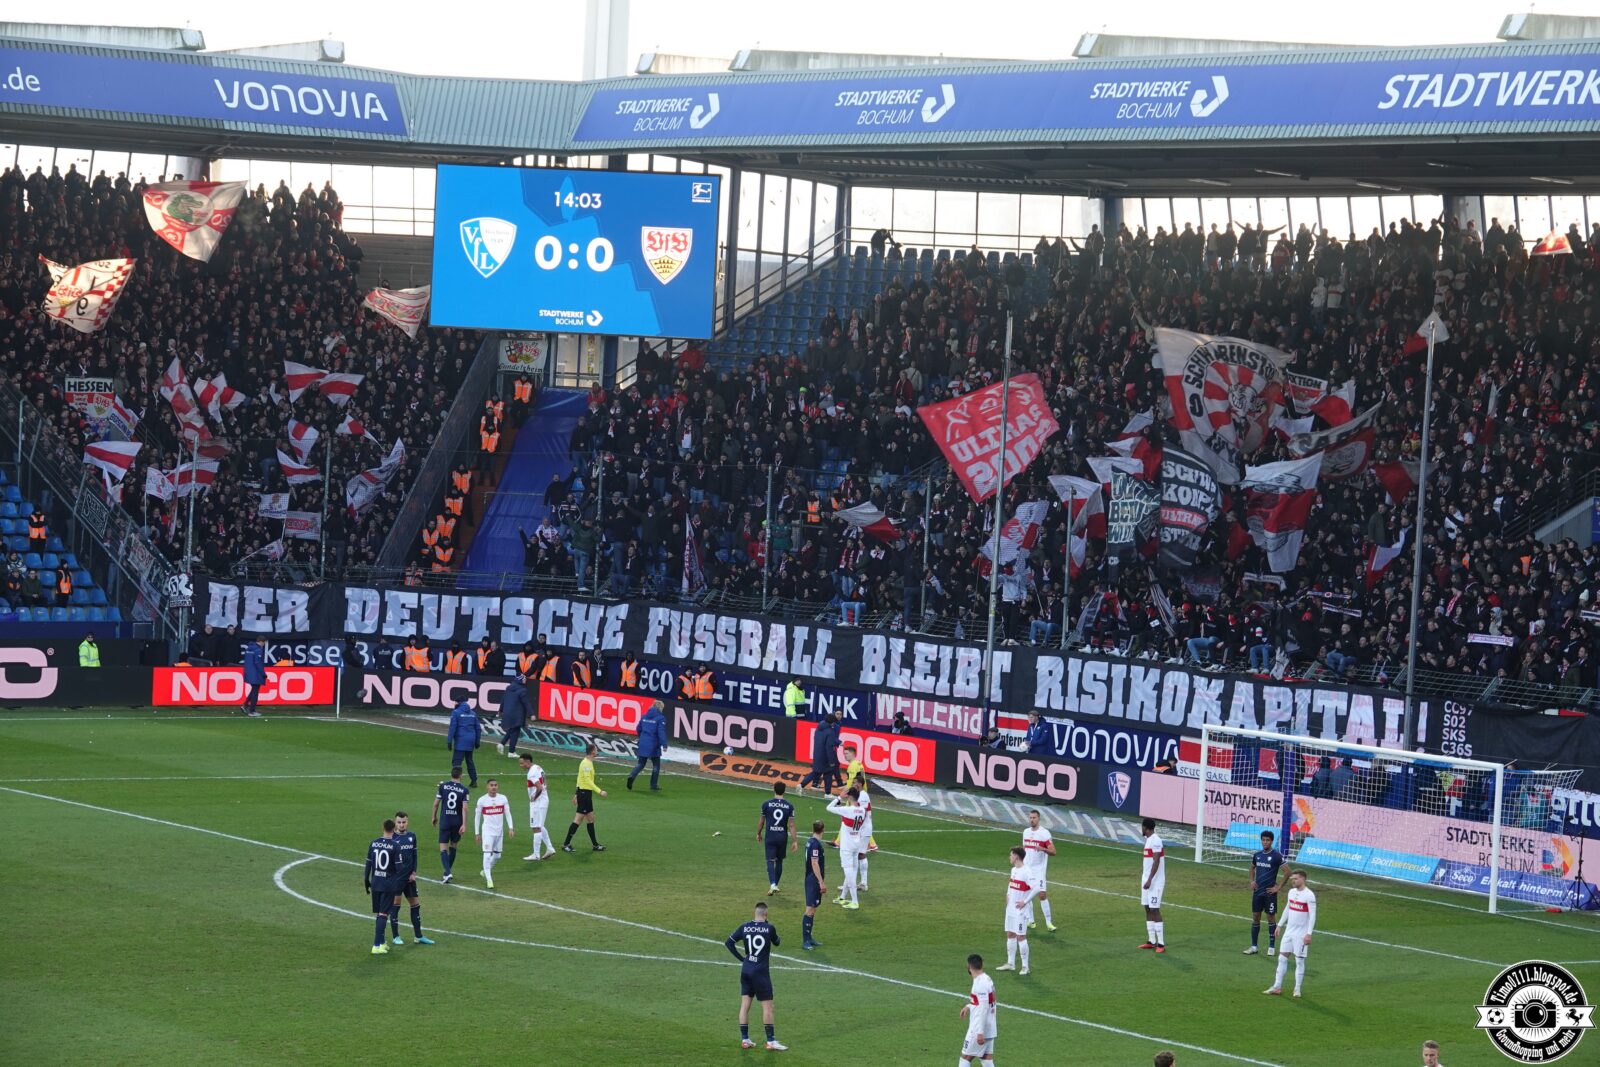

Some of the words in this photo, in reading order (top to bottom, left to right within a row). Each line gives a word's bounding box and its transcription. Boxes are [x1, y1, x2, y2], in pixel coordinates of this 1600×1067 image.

[835, 89, 923, 106] STADTWERKE
[1090, 80, 1191, 99] STADTWERKE
[615, 97, 693, 116] STADTWERKE
[1116, 102, 1182, 119] BOCHUM
[634, 116, 684, 132] BOCHUM
[857, 109, 914, 125] BOCHUM
[554, 192, 602, 209] 14:03
[539, 309, 583, 318] STADTWERKE
[555, 318, 583, 326] BOCHUM
[67, 380, 113, 393] HESSEN
[205, 581, 310, 633] DER
[344, 586, 629, 650] DEUTSCHE
[643, 607, 835, 680] FUSSBALL
[859, 634, 1012, 703] BLEIBT
[171, 671, 313, 702] NOCO
[549, 688, 642, 731] NOCO
[673, 707, 775, 753] NOCO
[1441, 728, 1466, 743] SKS
[809, 728, 918, 776] OCO
[956, 750, 1077, 801] NOCO
[447, 792, 458, 809] 8
[773, 809, 784, 826] 9
[373, 849, 390, 870] 10
[1451, 872, 1474, 883] Seco
[746, 935, 766, 957] 19
